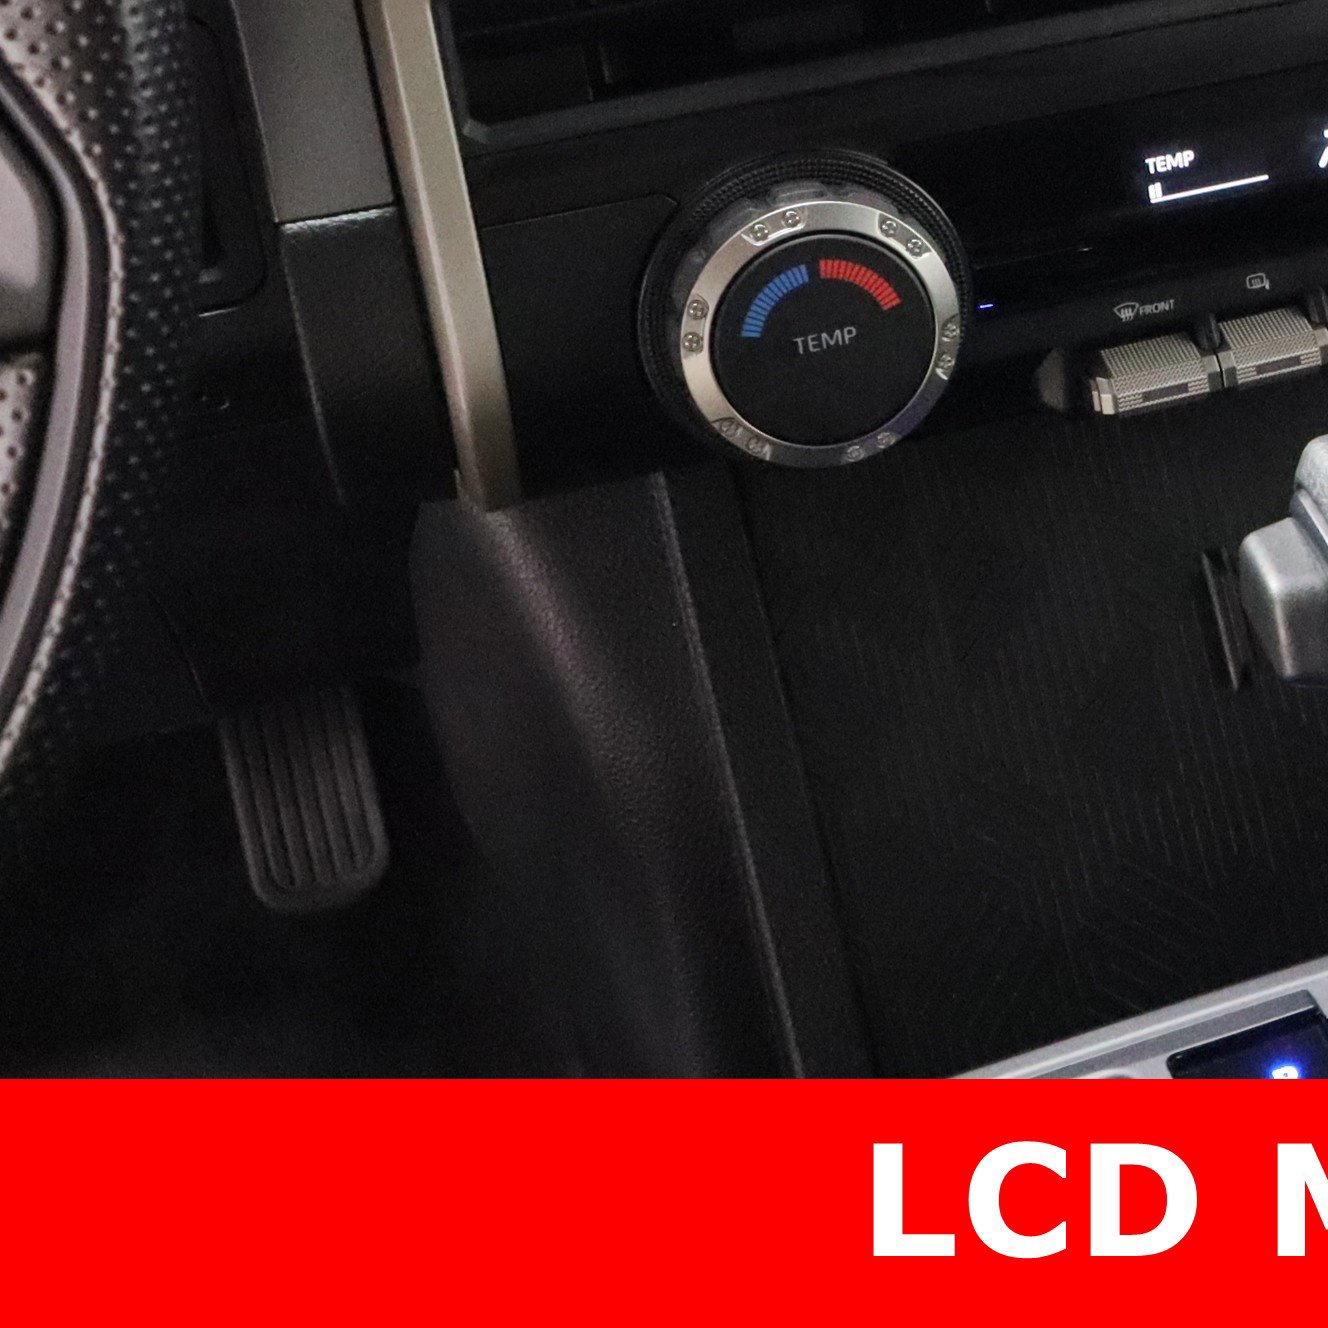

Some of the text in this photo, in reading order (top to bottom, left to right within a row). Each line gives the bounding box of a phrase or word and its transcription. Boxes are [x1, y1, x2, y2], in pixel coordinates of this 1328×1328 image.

[1144, 148, 1196, 175] TEMP
[1138, 298, 1176, 317] FRONT
[791, 325, 858, 355] TEMP
